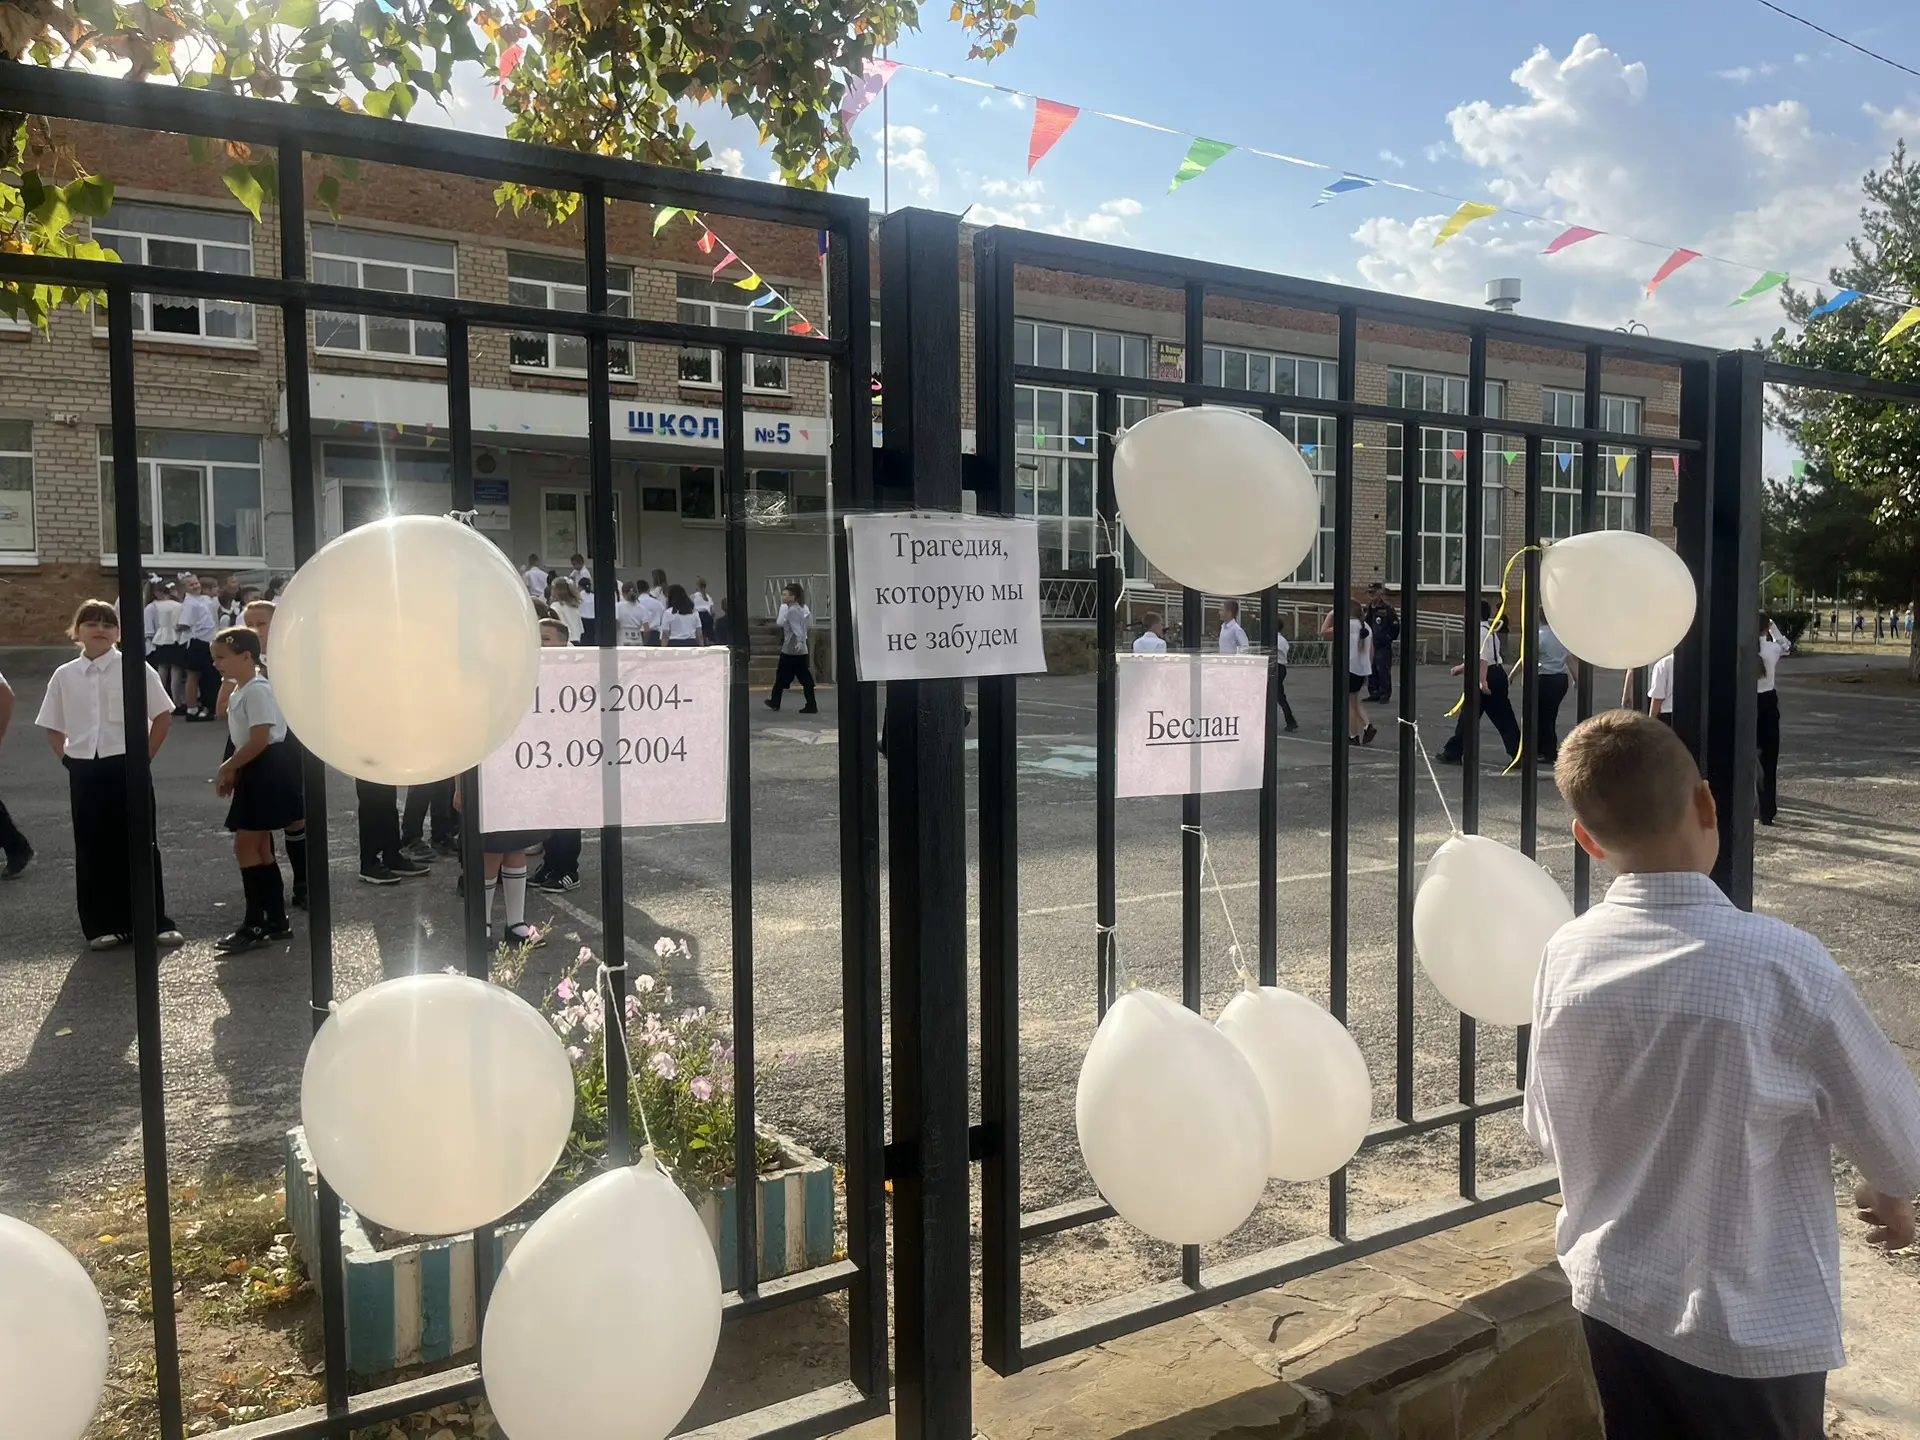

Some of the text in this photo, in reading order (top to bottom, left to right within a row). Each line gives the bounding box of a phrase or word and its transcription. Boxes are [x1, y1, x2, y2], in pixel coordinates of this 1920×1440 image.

[628, 410, 792, 444] ШКОЛ №5
[890, 532, 1009, 564] Трагедия,
[875, 583, 1024, 610] которую мы
[887, 623, 1018, 654] не забудем
[532, 683, 693, 714] 1.09.2004-
[1146, 710, 1240, 740] Беслан
[515, 736, 688, 769] 03.09.2004
